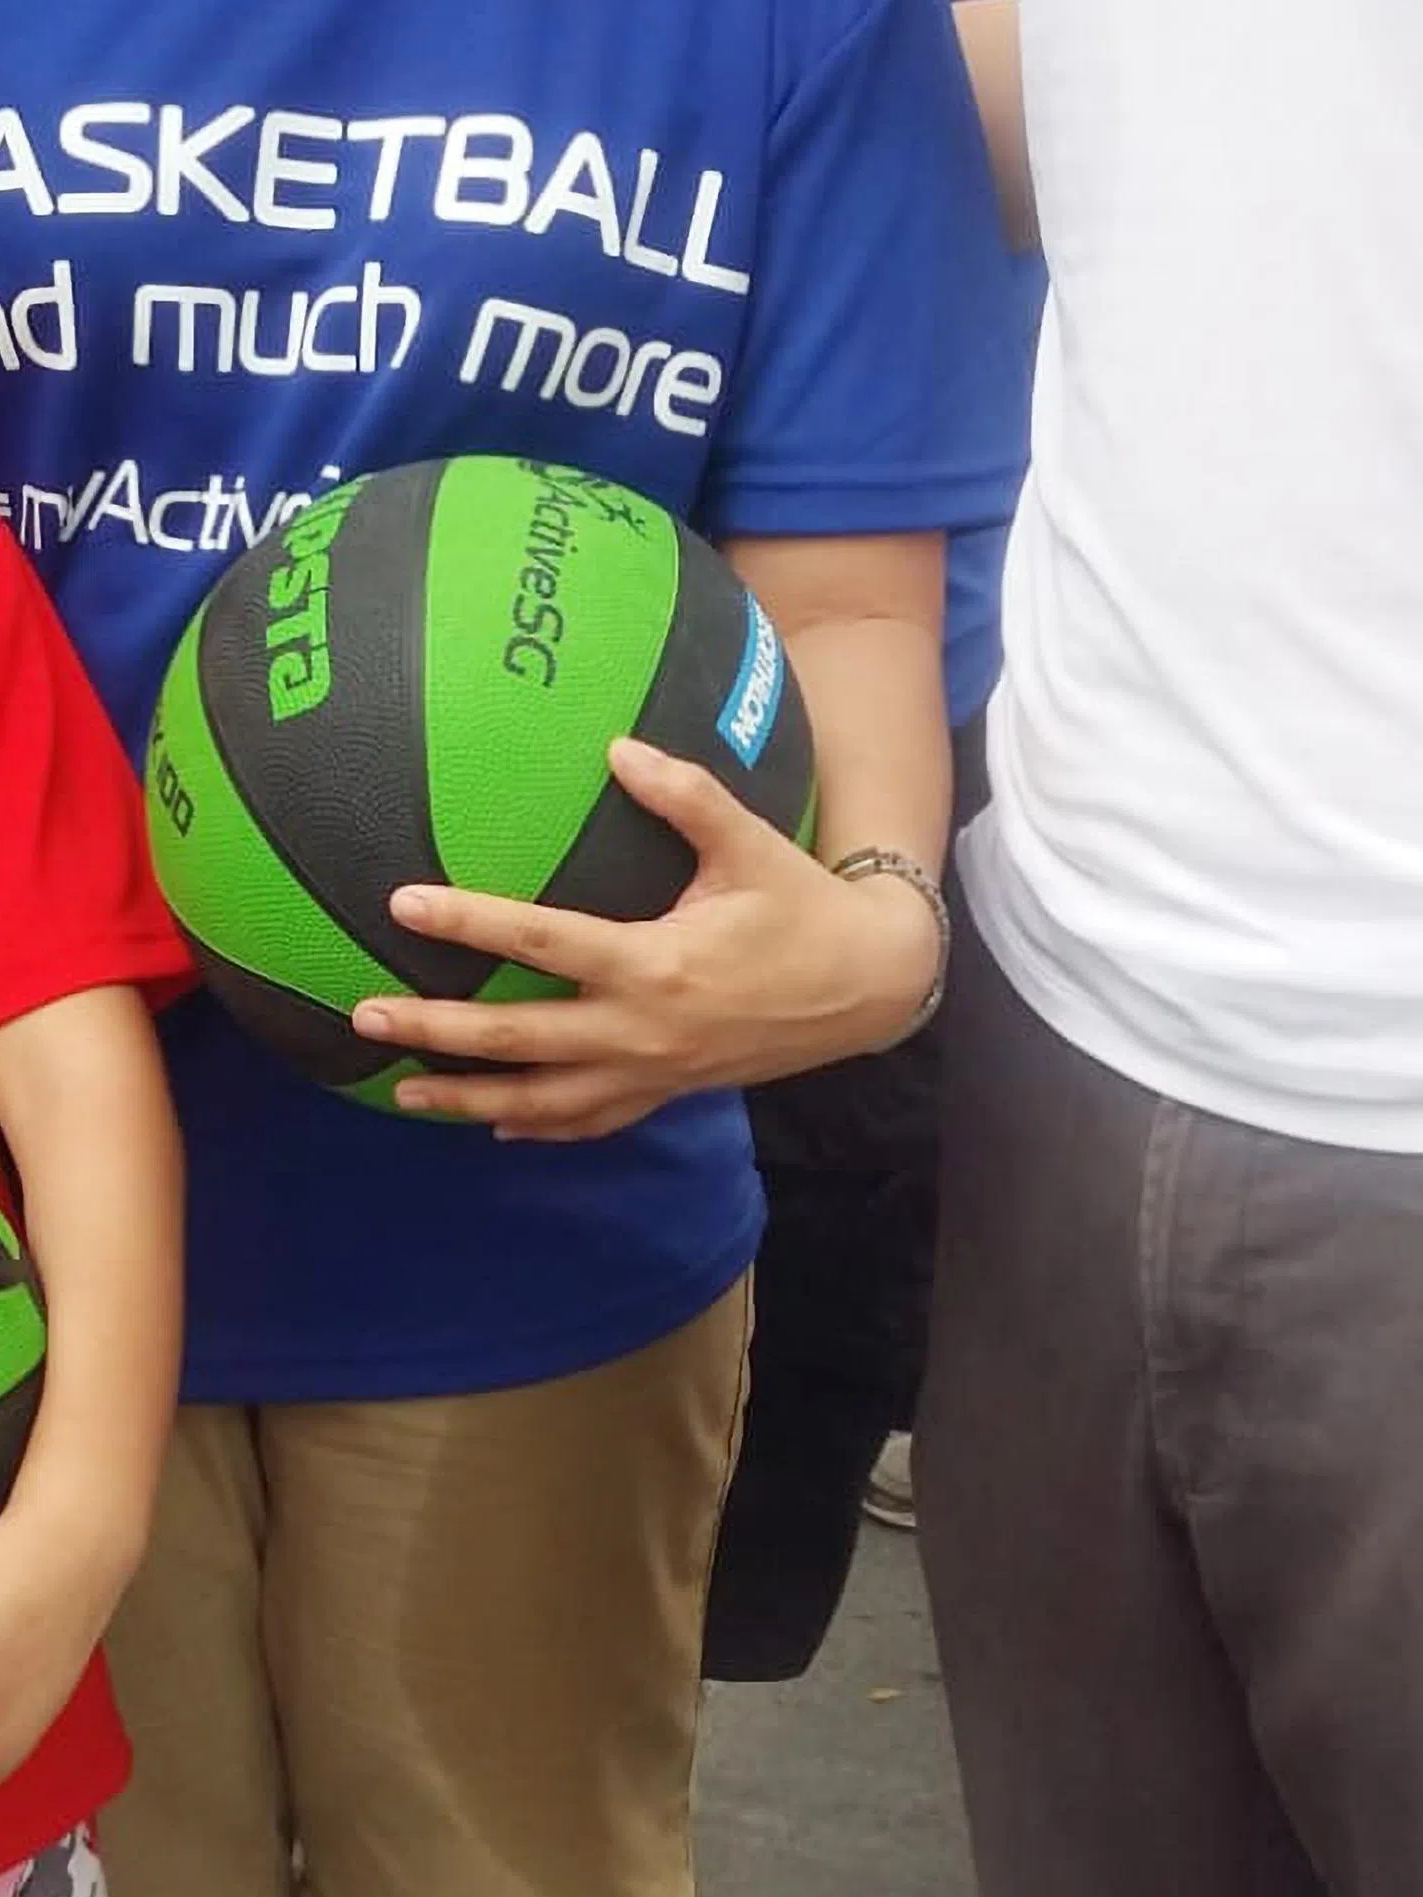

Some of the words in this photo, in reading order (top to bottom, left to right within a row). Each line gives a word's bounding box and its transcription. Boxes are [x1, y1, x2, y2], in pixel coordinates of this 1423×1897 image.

[132, 262, 420, 375] much
[459, 296, 721, 436] more
[502, 485, 588, 688] ActiveSG
